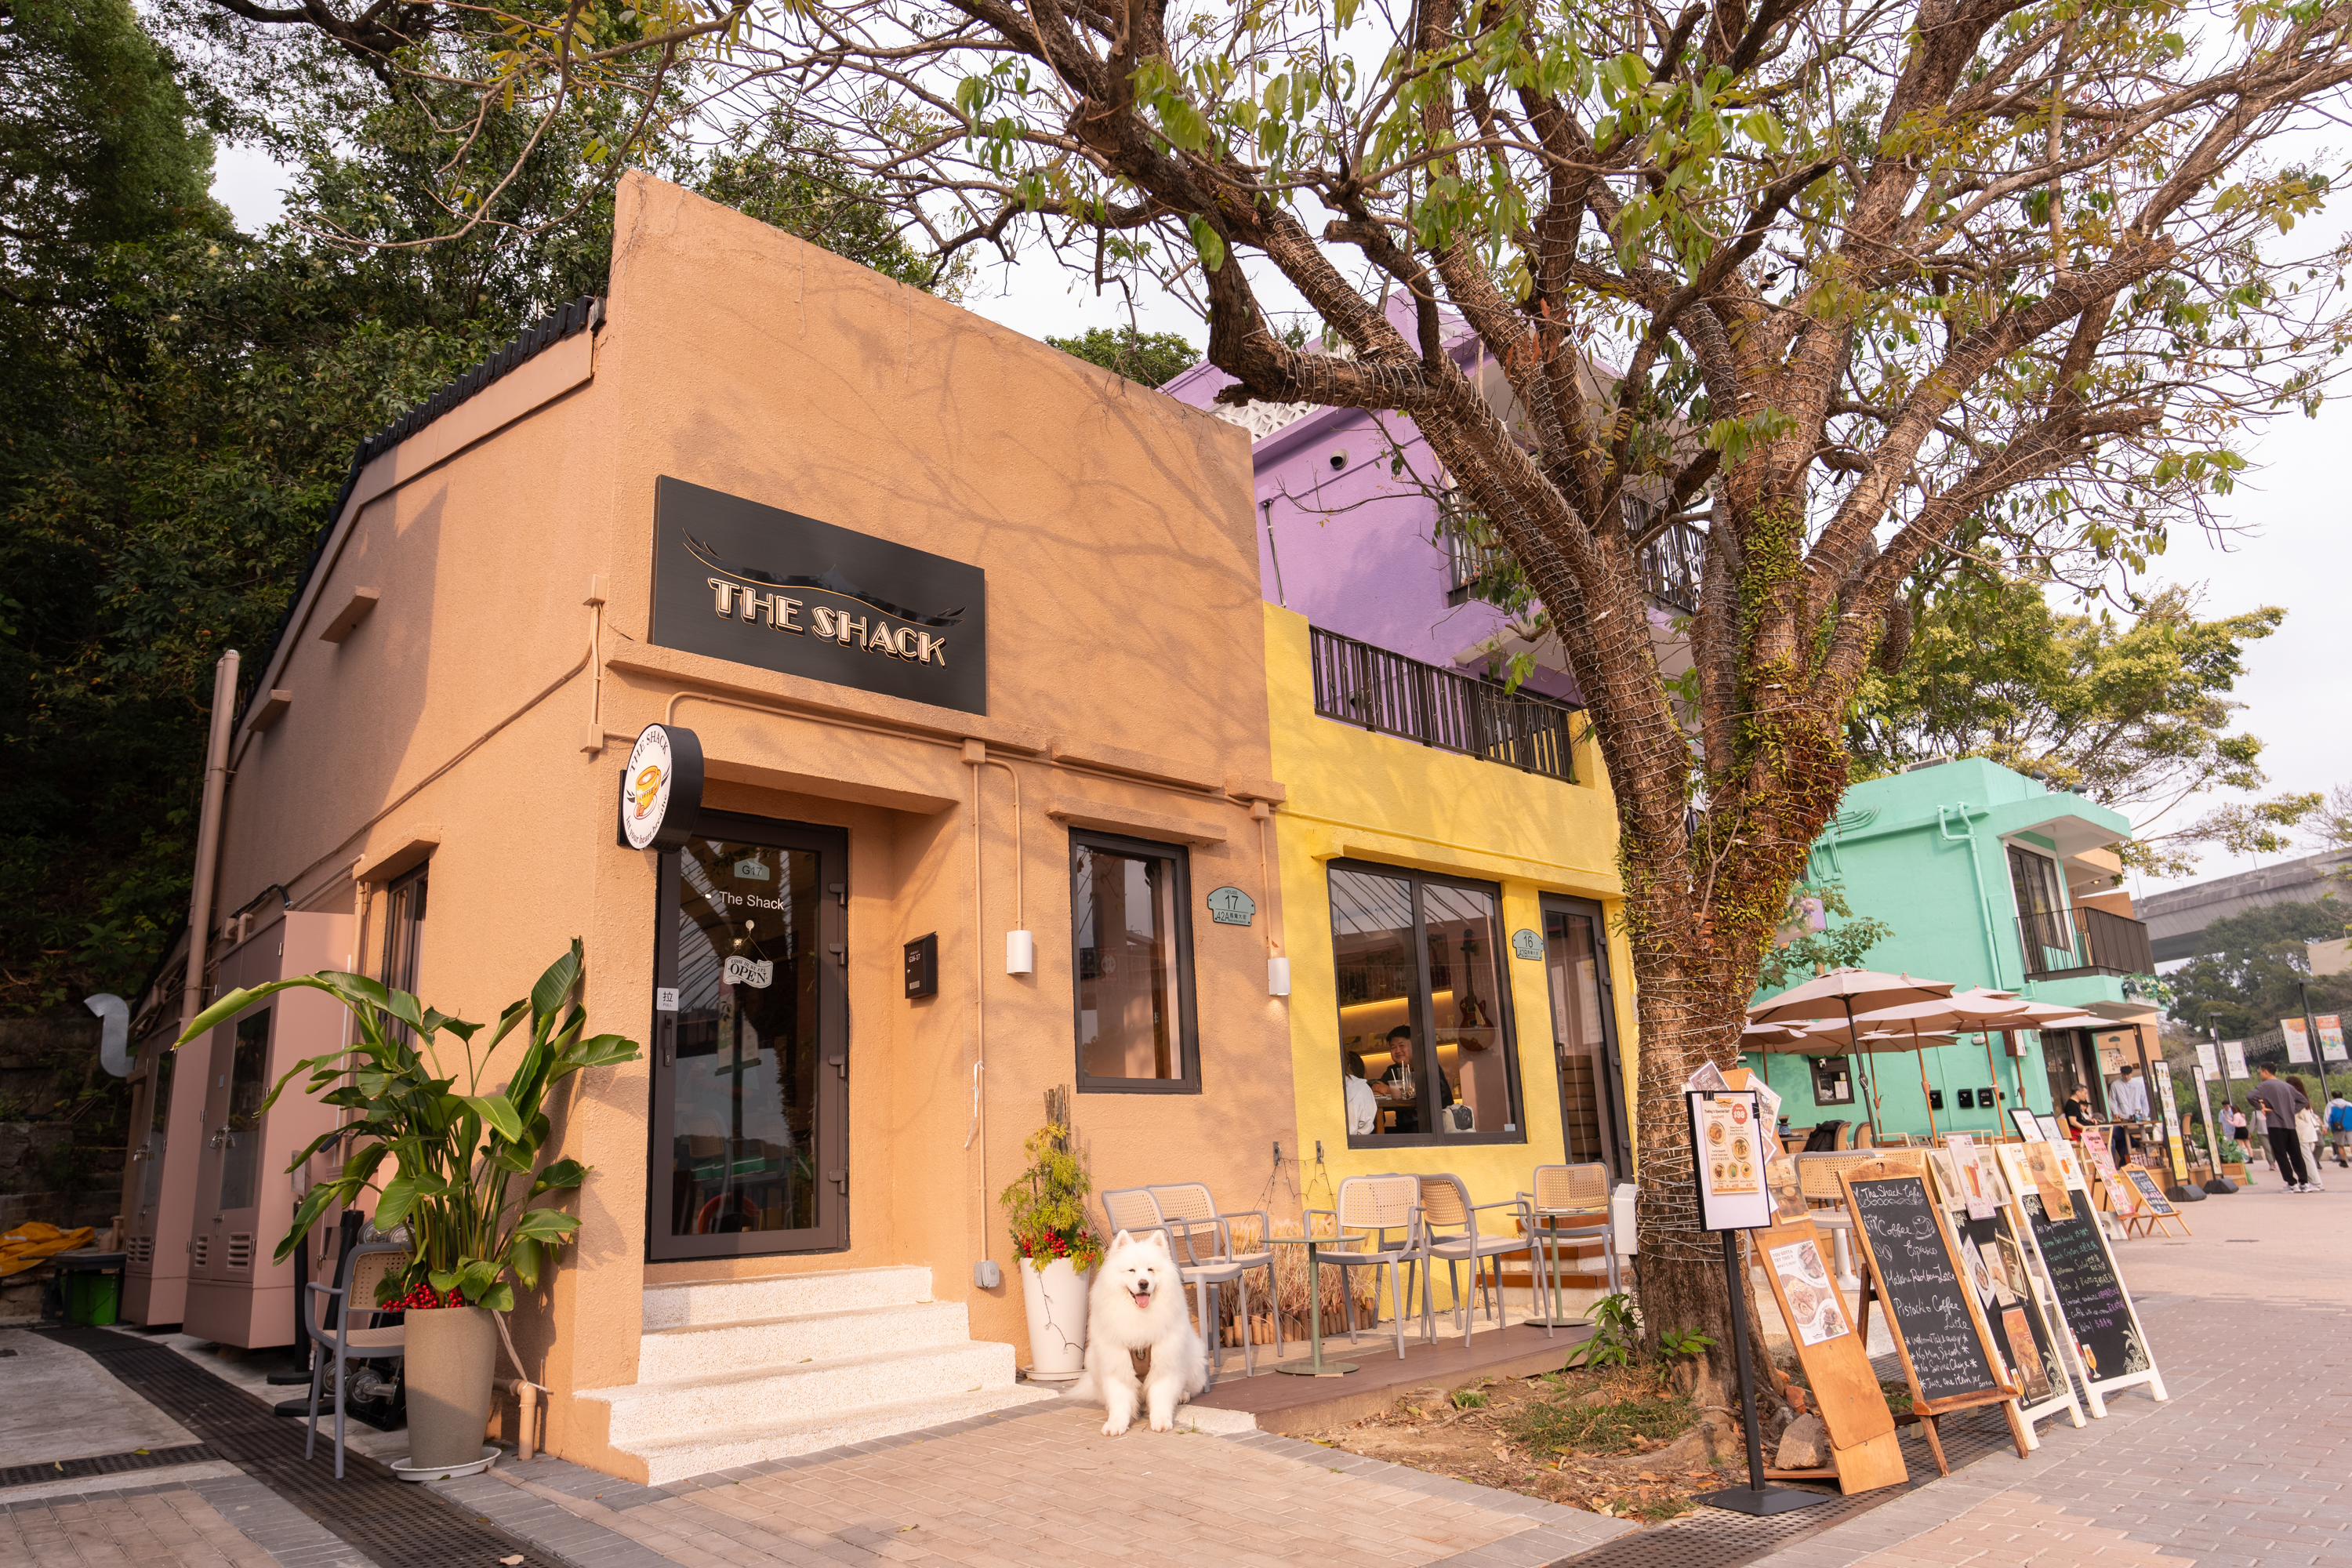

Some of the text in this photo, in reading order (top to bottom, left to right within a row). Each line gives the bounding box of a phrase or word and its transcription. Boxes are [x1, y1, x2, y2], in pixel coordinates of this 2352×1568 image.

[708, 577, 947, 670] THE SHACK
[630, 731, 668, 772] THE SHACK
[639, 787, 654, 800] COFFEE
[629, 830, 639, 844] your
[639, 833, 652, 844] heart
[652, 793, 667, 833] breathe
[742, 865, 762, 877] G17
[719, 891, 784, 910] The Shack
[1225, 895, 1238, 909] 17
[1217, 911, 1229, 921] 42A
[1523, 935, 1534, 948] 16
[909, 953, 920, 963] G16-17
[730, 963, 767, 984] OPEN
[662, 991, 673, 1002] 拉
[1860, 1185, 1922, 1204] The Shack Cafe
[1878, 1219, 1913, 1237] Coffee
[2044, 1224, 2053, 1234] Day
[2042, 1239, 2055, 1249] German
[2049, 1247, 2080, 1262] French Oysters
[2074, 1259, 2089, 1270] Salad
[1884, 1269, 1911, 1287] Matcha
[1933, 1264, 1955, 1283] Latte
[2058, 1281, 2071, 1293] Pasta
[1893, 1294, 1961, 1317] Pistachio Coffee
[1944, 1313, 1971, 1330] Latte
[1915, 1343, 1961, 1360] No Min Spend
[1920, 1360, 1928, 1373] No
[1926, 1377, 1942, 1388] Just
[1954, 1374, 1970, 1385] item
[1972, 1375, 1980, 1386] per
[1979, 1380, 1994, 1389] person
